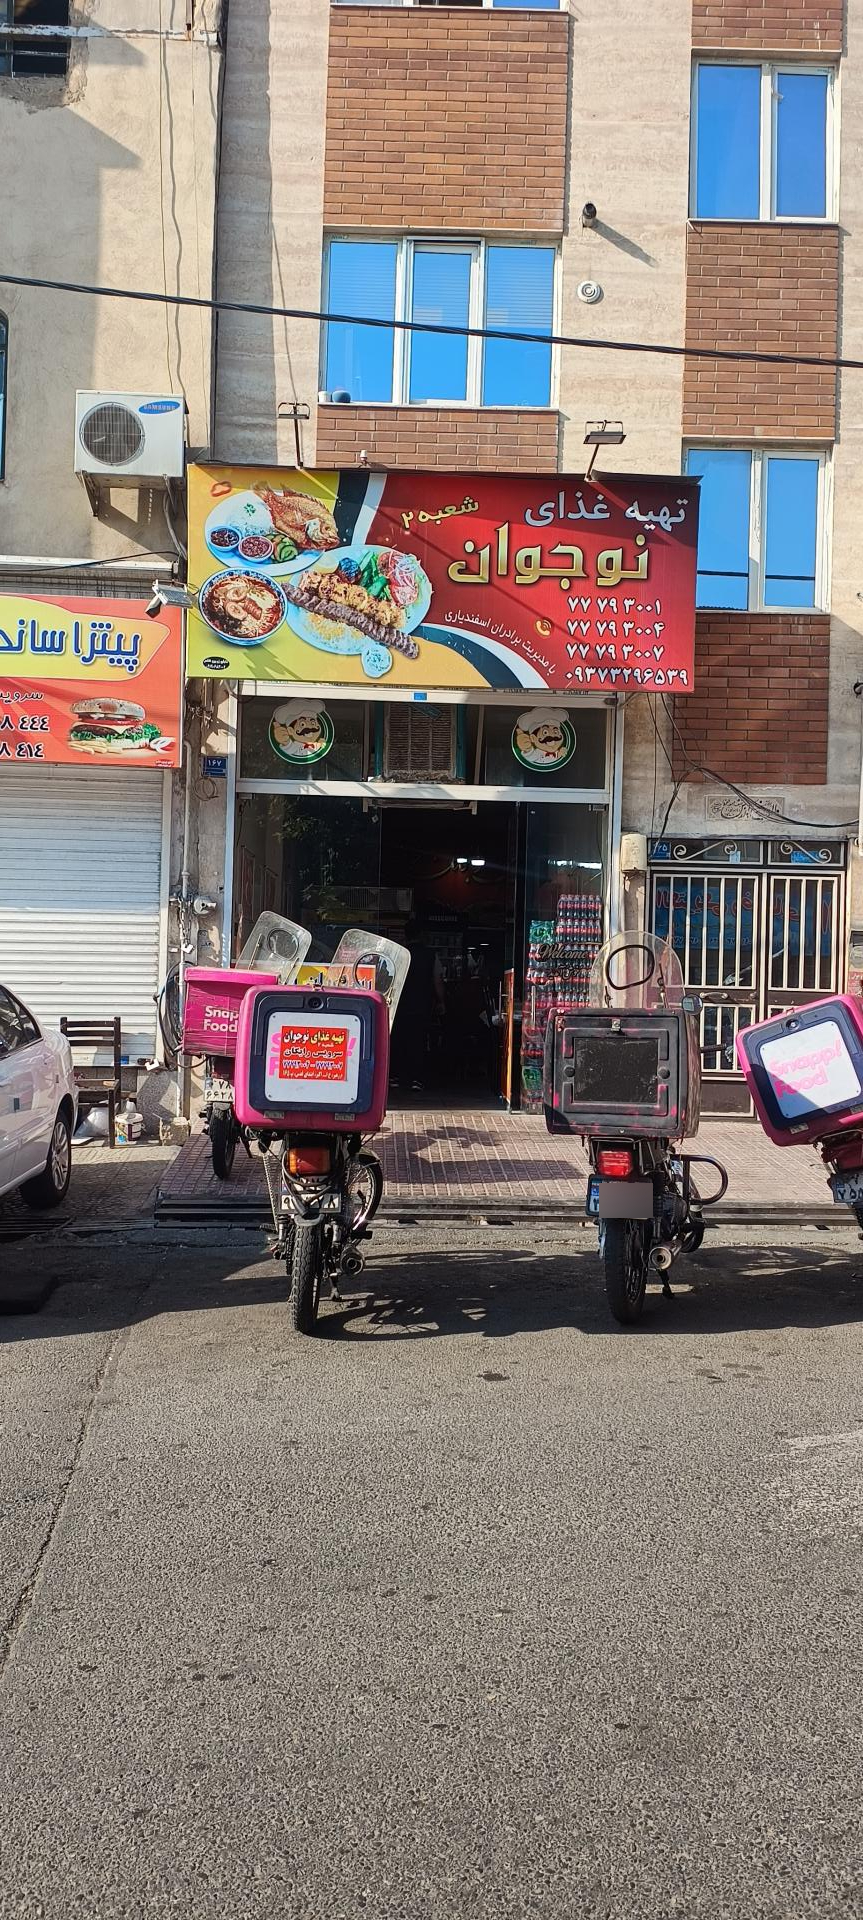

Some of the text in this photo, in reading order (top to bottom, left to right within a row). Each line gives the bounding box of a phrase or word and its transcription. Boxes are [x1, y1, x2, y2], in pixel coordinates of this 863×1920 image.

[401, 495, 480, 529] شعبه ۲
[524, 490, 689, 533] تهیه غذای
[448, 521, 650, 590] نوجوان
[567, 596, 662, 615] ۷۷ ۷۹ ۳۰۰۱
[566, 619, 665, 638] ۷۷ ۷۹ ۳۰۰۴
[74, 620, 141, 672] پیتزا
[444, 610, 556, 676] با مدیریت برادران اسفندیاری
[565, 643, 665, 661] ۷۷ ۷۹ ۳۰۰۷
[565, 665, 689, 686] ۰۹۳۷۳۲۹۶۵۳۹
[208, 759, 222, 767] ۱۶۷
[538, 943, 588, 959] Welcome
[203, 1018, 238, 1032] Food
[283, 1029, 310, 1044] نوجوان
[310, 1030, 330, 1044] غذای
[331, 1031, 345, 1044] تهیه
[284, 1047, 343, 1059] سرویس رایگان
[774, 1065, 828, 1099] Food
